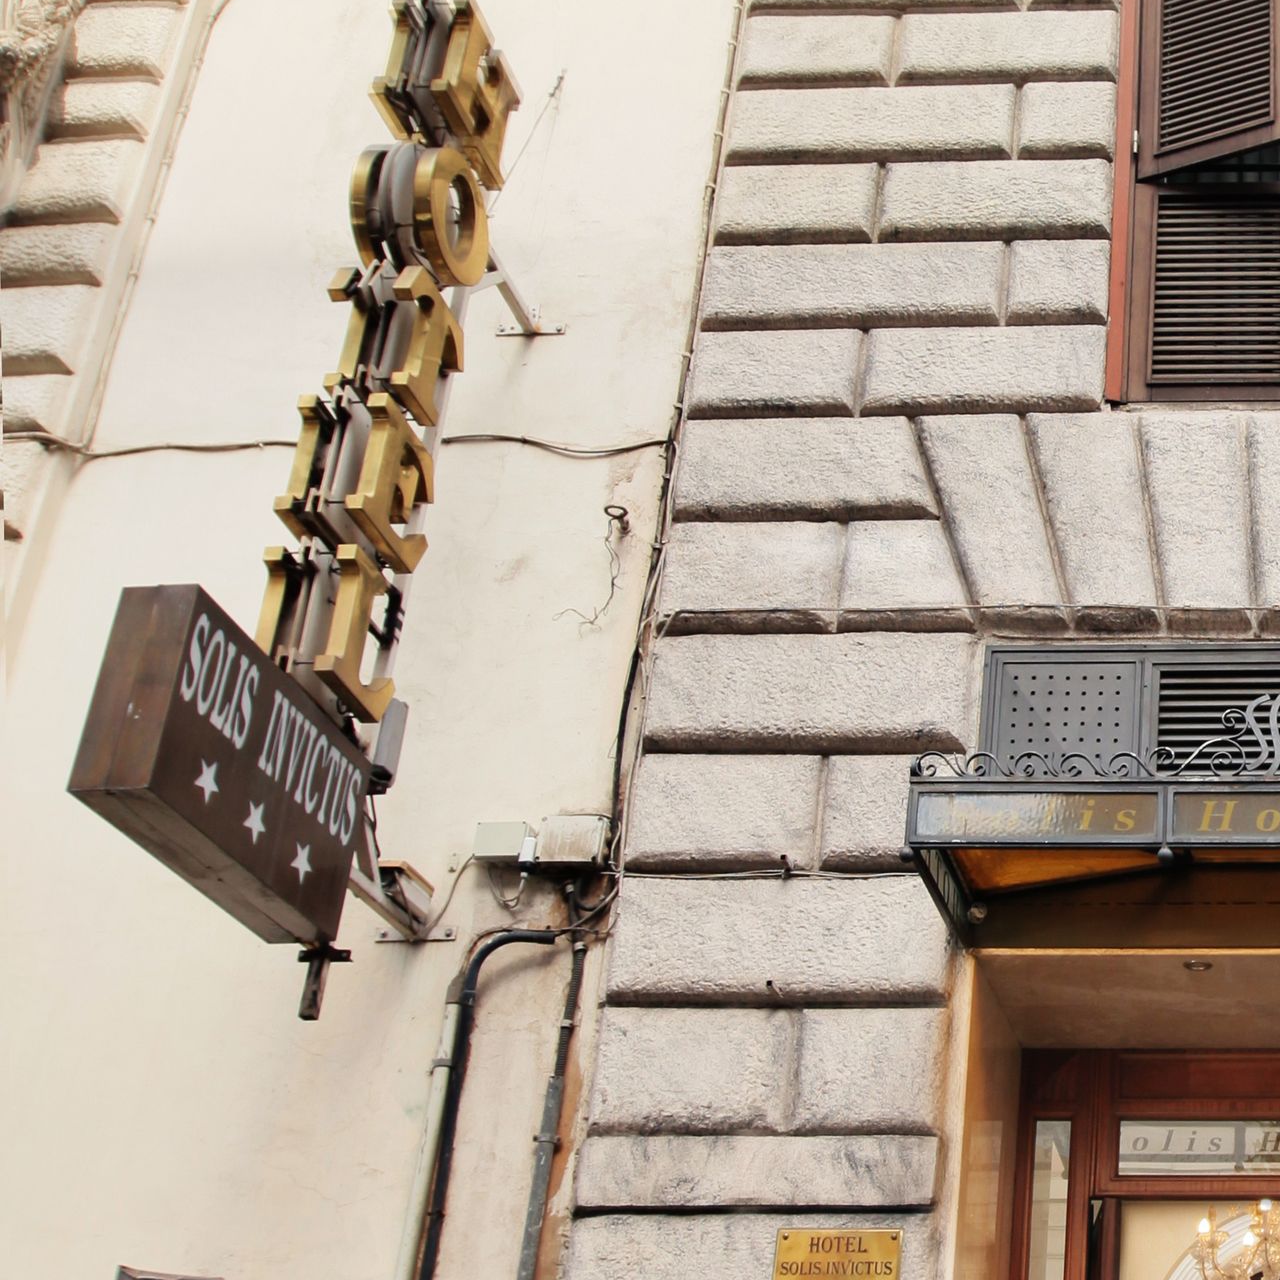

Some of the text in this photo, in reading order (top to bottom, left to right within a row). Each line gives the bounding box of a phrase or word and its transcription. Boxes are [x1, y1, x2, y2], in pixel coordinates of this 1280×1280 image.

[180, 613, 364, 847] SOLIS INVICTUS
[809, 1236, 868, 1253] HOTEL
[779, 1261, 893, 1276] SOLIS INVICTUS
